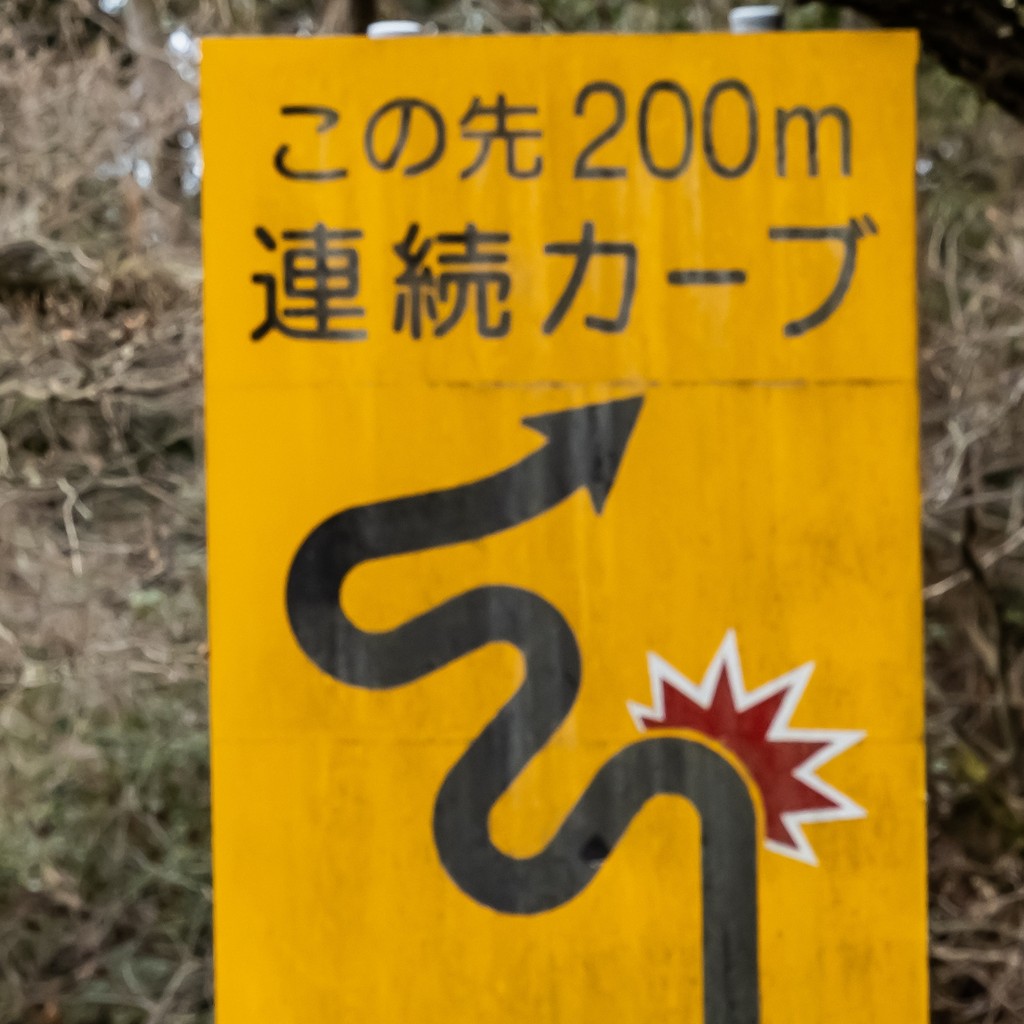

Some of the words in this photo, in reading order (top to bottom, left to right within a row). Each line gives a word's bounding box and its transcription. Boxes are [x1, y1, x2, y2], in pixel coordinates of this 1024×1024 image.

[251, 214, 879, 342] 連続カーブ
